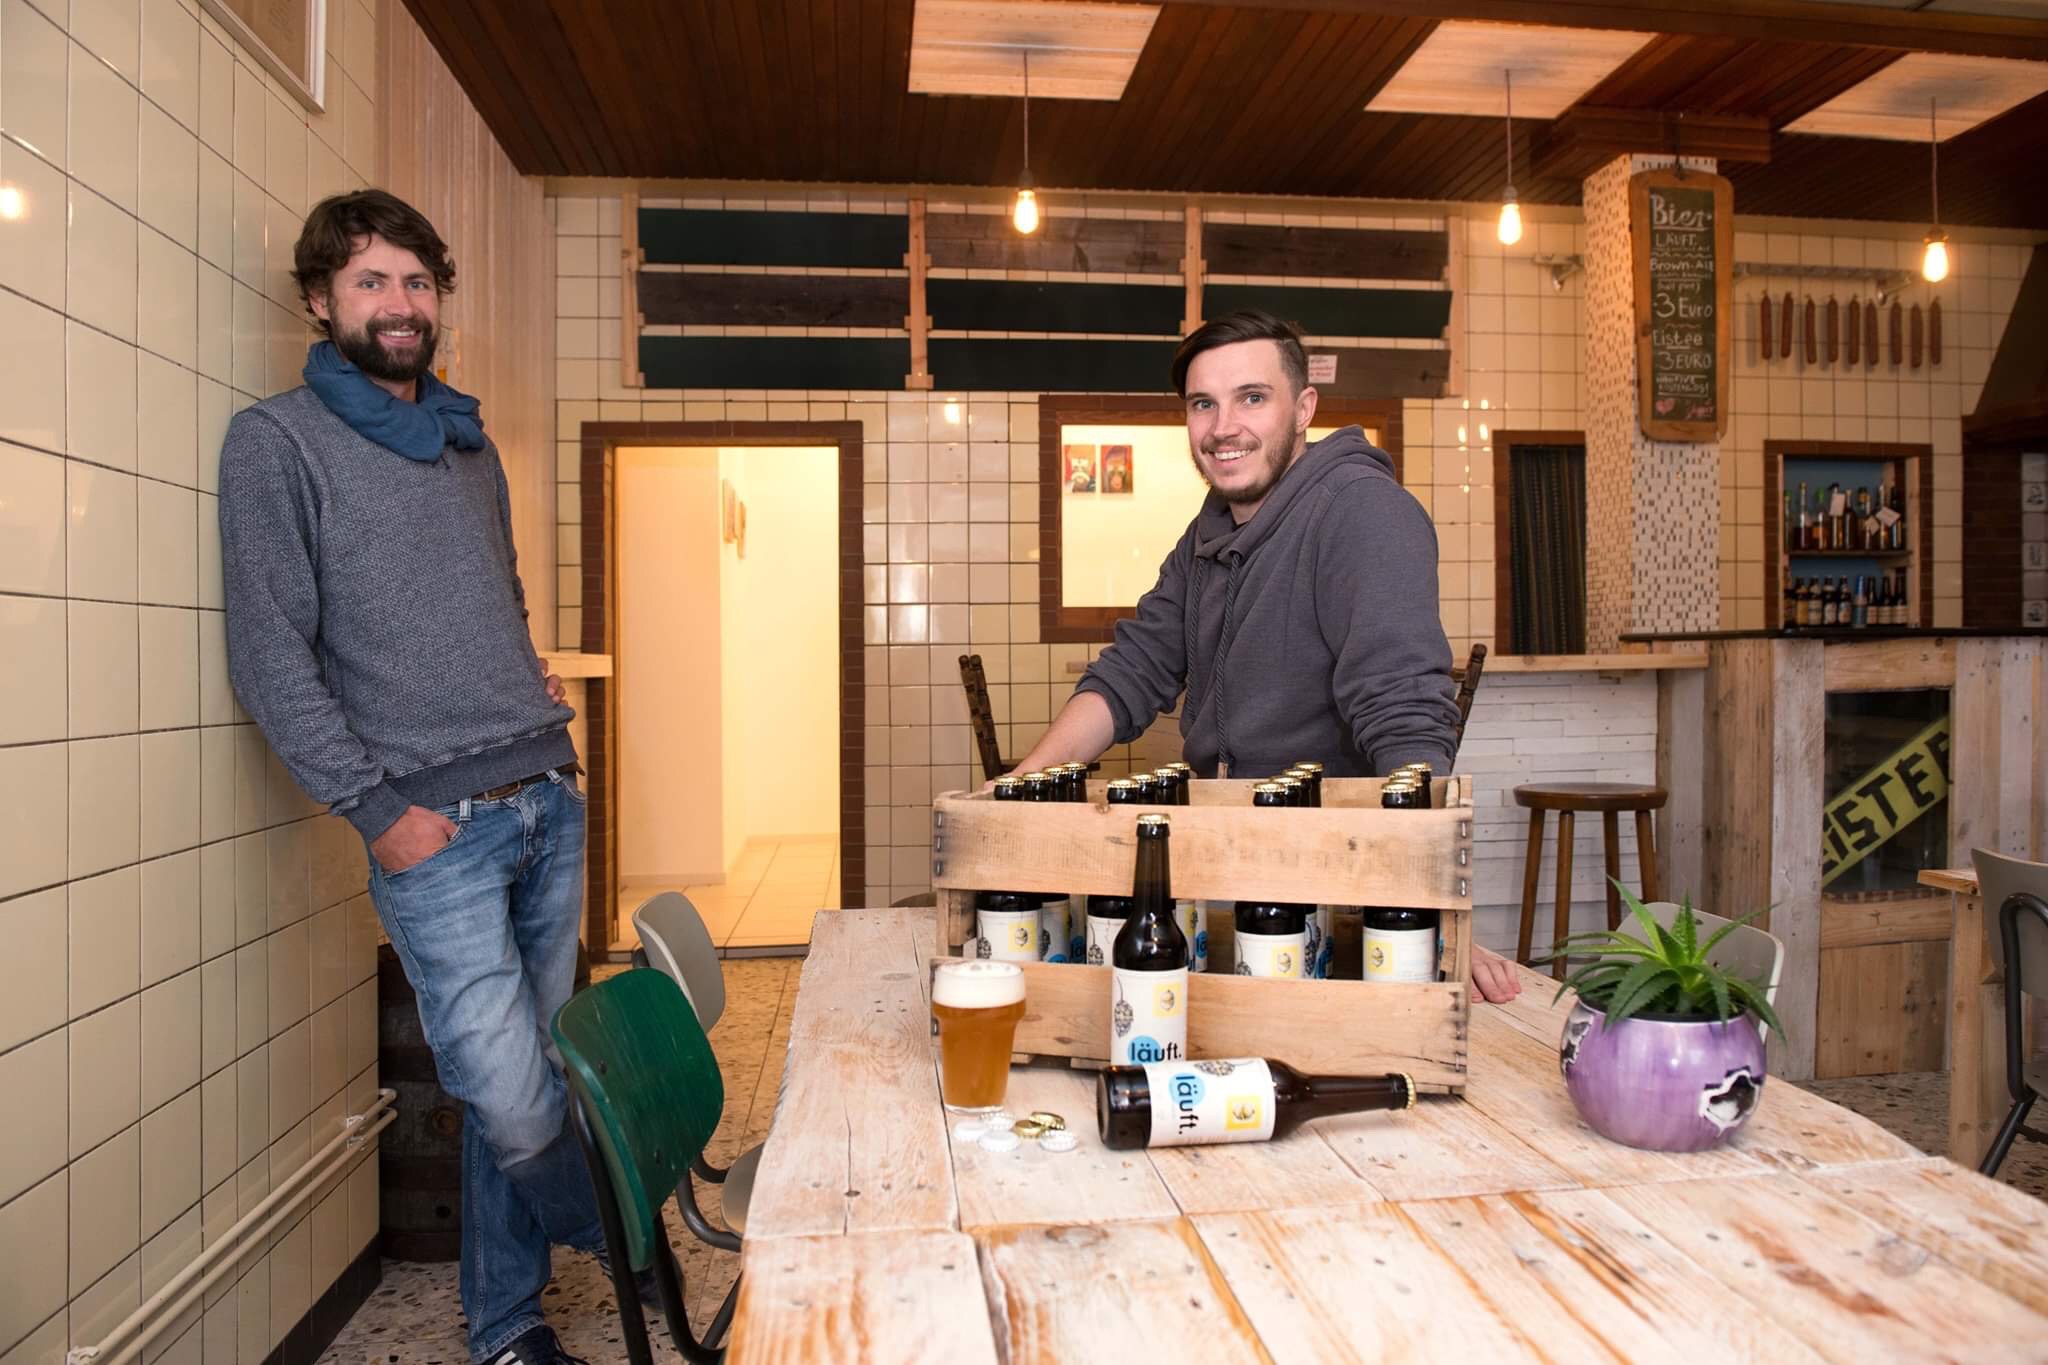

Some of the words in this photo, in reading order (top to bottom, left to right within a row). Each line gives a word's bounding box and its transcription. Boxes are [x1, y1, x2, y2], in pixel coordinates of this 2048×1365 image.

[1656, 292, 1676, 318] 3
[1652, 329, 1703, 346] Eistee
[1658, 351, 1674, 369] 3
[1676, 353, 1712, 369] EURO
[1131, 1042, 1182, 1062] läuft.
[1176, 1076, 1199, 1134] läuft.
